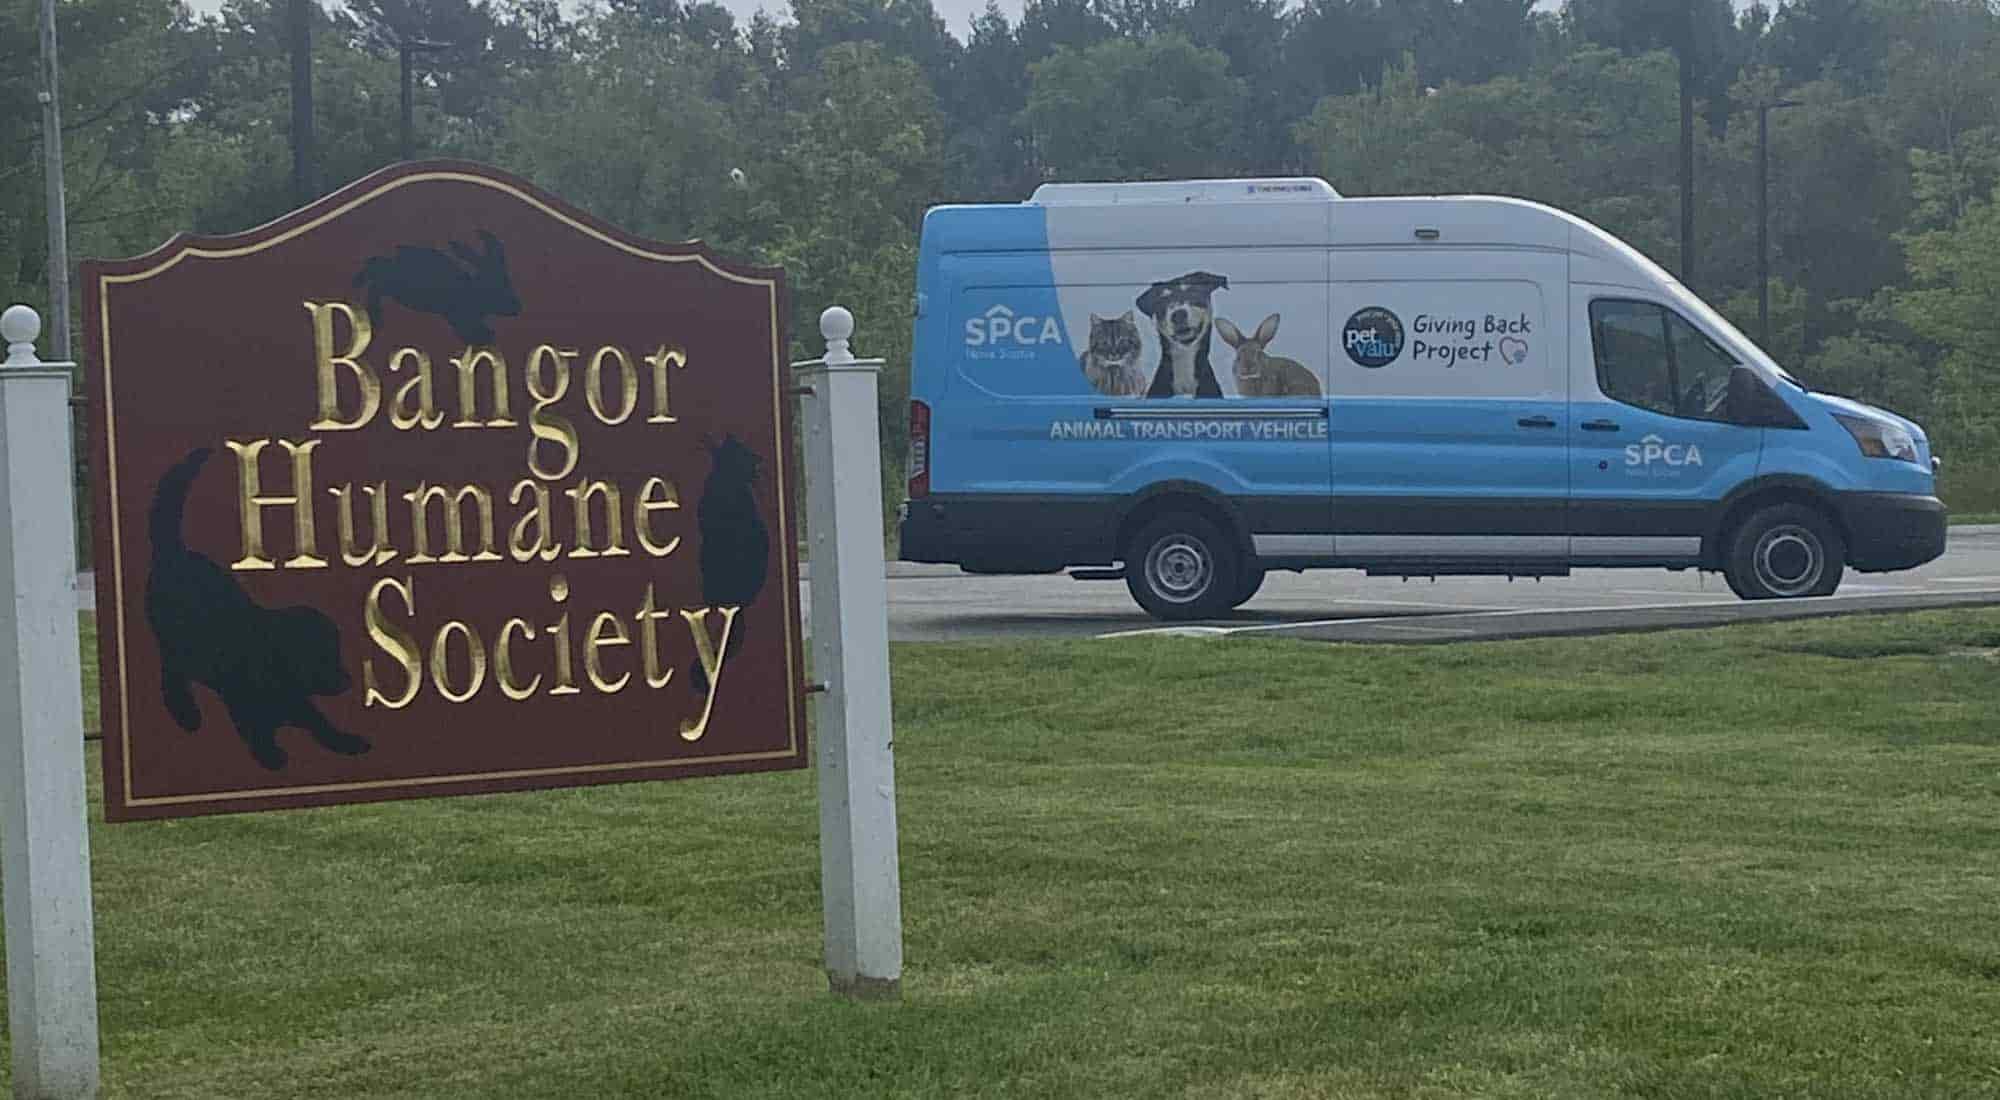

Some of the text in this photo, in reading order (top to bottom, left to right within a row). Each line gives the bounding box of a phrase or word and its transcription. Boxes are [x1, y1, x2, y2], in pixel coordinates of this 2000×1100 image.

[965, 316, 1062, 345] SPCA
[1346, 328, 1376, 349] pet
[1413, 314, 1476, 340] Giving
[1484, 312, 1531, 334] Back
[1357, 340, 1393, 357] valu
[1413, 340, 1493, 368] Project
[303, 300, 688, 481] Bangor
[1050, 419, 1328, 440] ANIMAL TRANSPORT VEHICLE
[1624, 443, 1703, 466] SPCA
[225, 437, 682, 571] Humane
[363, 575, 742, 742] Society
